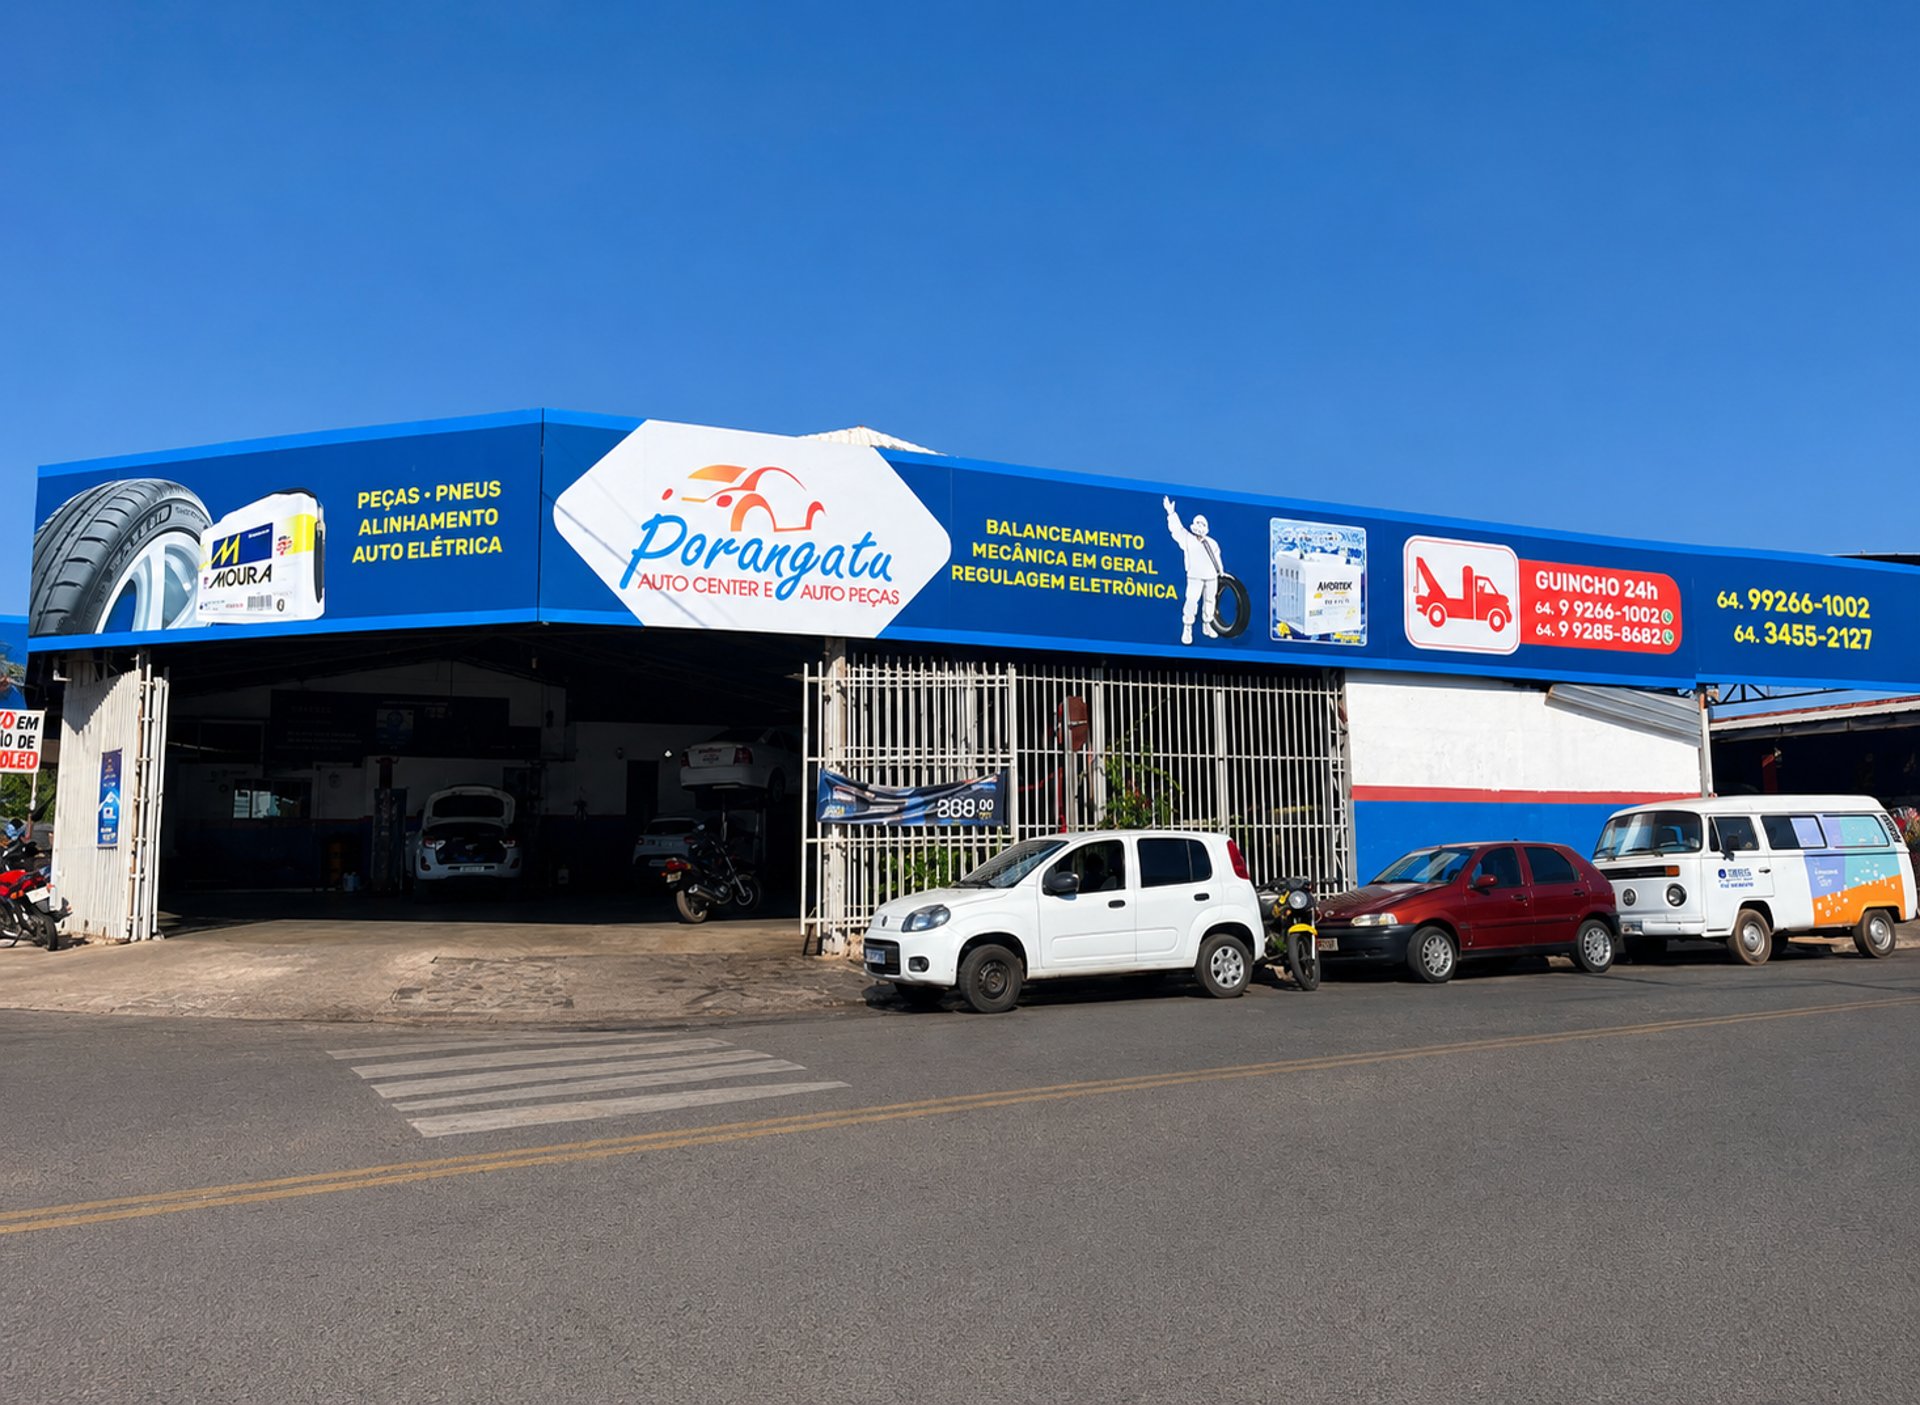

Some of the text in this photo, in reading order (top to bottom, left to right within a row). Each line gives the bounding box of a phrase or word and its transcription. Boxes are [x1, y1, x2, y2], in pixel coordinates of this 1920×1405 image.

[357, 480, 501, 511] PEÇAS PNEUS
[358, 508, 499, 536] ALINHAMENTO
[986, 519, 1145, 550] BALANCEAMENTO
[352, 535, 503, 563] AUTO ELÉTRICA
[619, 513, 893, 601] Porangatu
[972, 542, 1158, 575] MECÂNICA EM GERAL
[208, 563, 273, 589] MOURA
[637, 573, 900, 607] AUTO CENTER E AUTO PEÇAS
[951, 565, 1178, 600] REGULAGEM ELETRÔNICA
[1535, 570, 1659, 600] GUINCHO 24h
[1535, 599, 1660, 624] 64. 9 9266-1002
[1716, 588, 1871, 619] 64. 99266-1002
[1535, 620, 1661, 645] 64. 9 9285-8682
[1734, 621, 1873, 650] 64. 3455-2127
[16, 715, 40, 731] EM
[17, 734, 36, 749] DE
